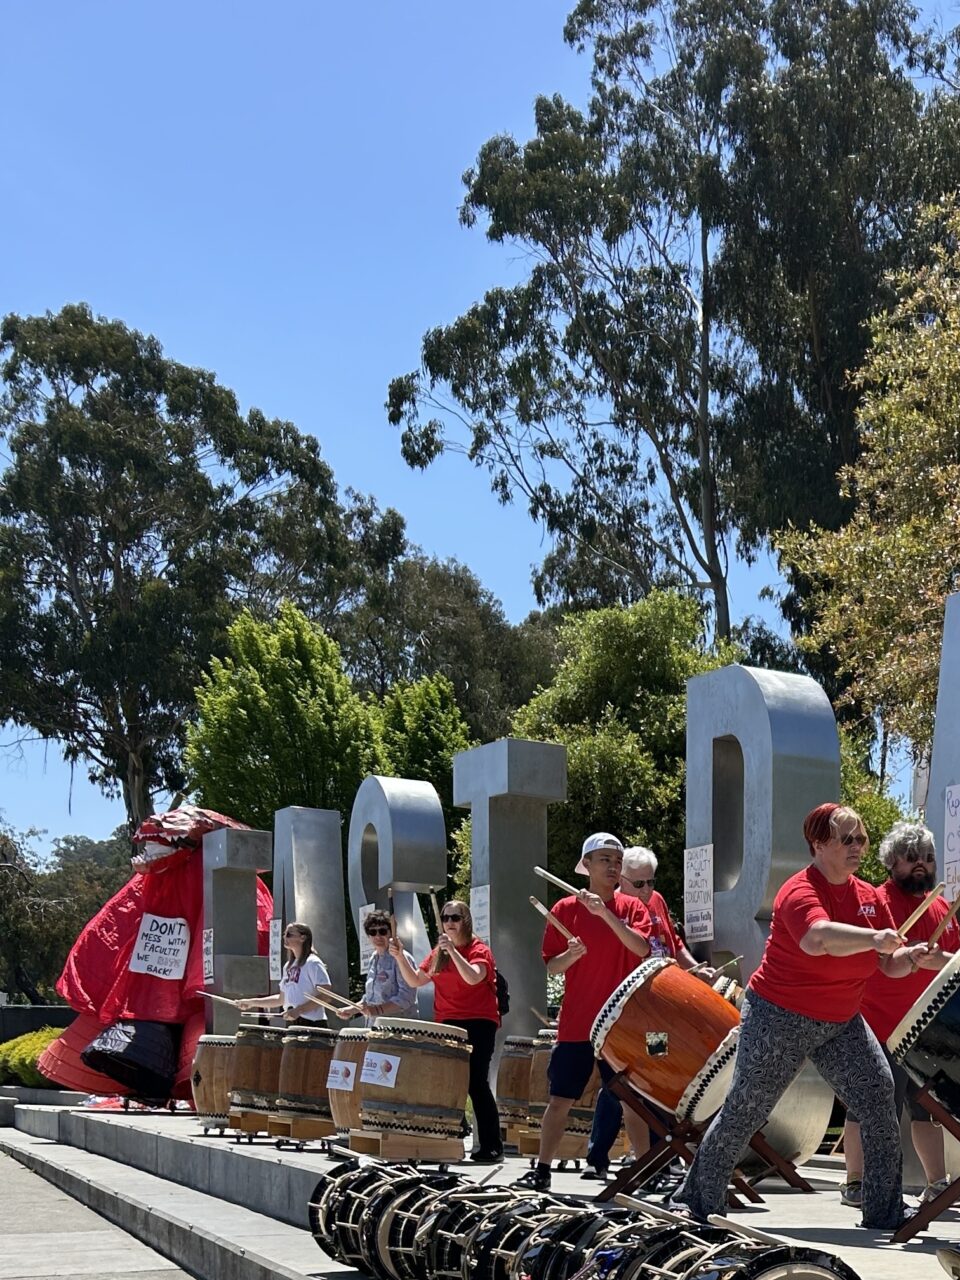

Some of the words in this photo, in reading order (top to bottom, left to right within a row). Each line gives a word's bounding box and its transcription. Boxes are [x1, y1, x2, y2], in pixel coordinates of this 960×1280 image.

[150, 919, 186, 936] DON'T
[141, 932, 162, 943] MESS
[168, 938, 187, 947] WITH
[144, 942, 180, 957] FACULTY!
[137, 952, 151, 961] WE
[146, 964, 172, 977] BACK!
